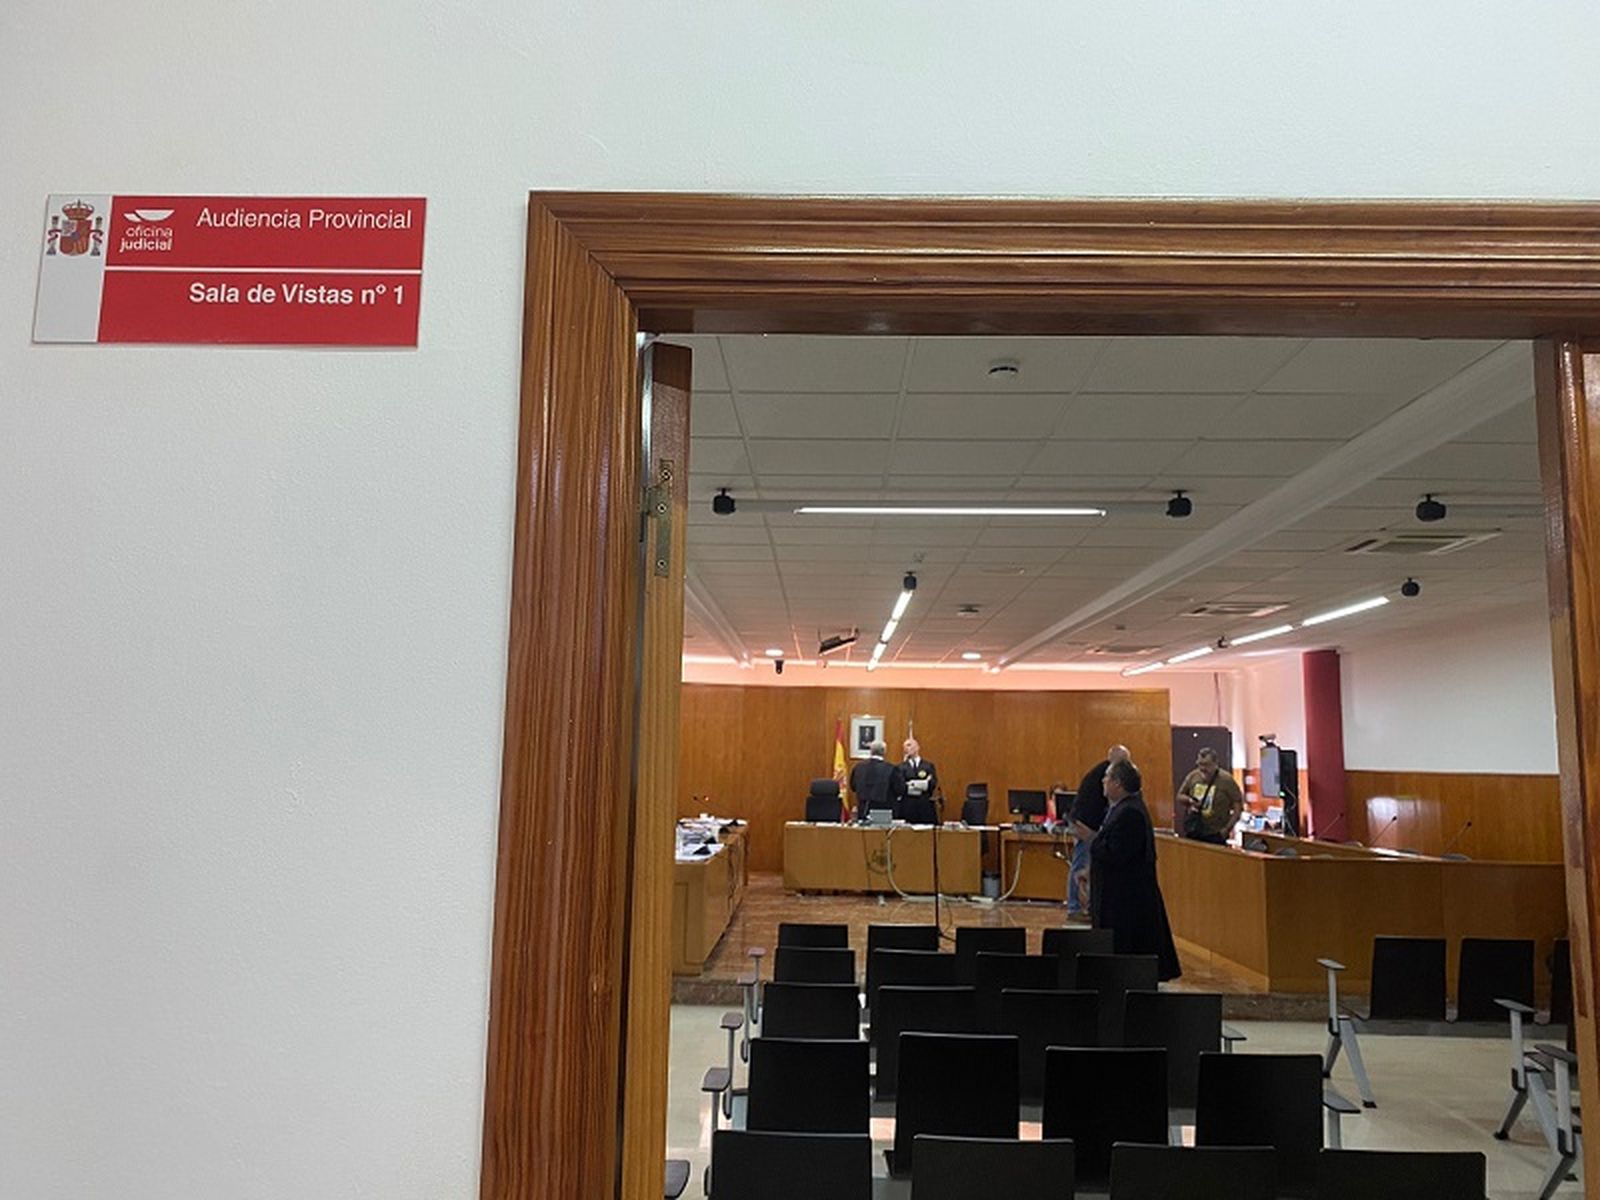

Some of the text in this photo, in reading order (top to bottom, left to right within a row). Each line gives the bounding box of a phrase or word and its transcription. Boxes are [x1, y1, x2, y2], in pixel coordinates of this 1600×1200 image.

[196, 207, 412, 231] Audiencia Provincial
[125, 226, 173, 238] oficina
[119, 238, 173, 252] judicial
[189, 282, 240, 304] Sala
[246, 283, 276, 304] de
[281, 284, 354, 305] Vistas
[393, 285, 404, 305] 1
